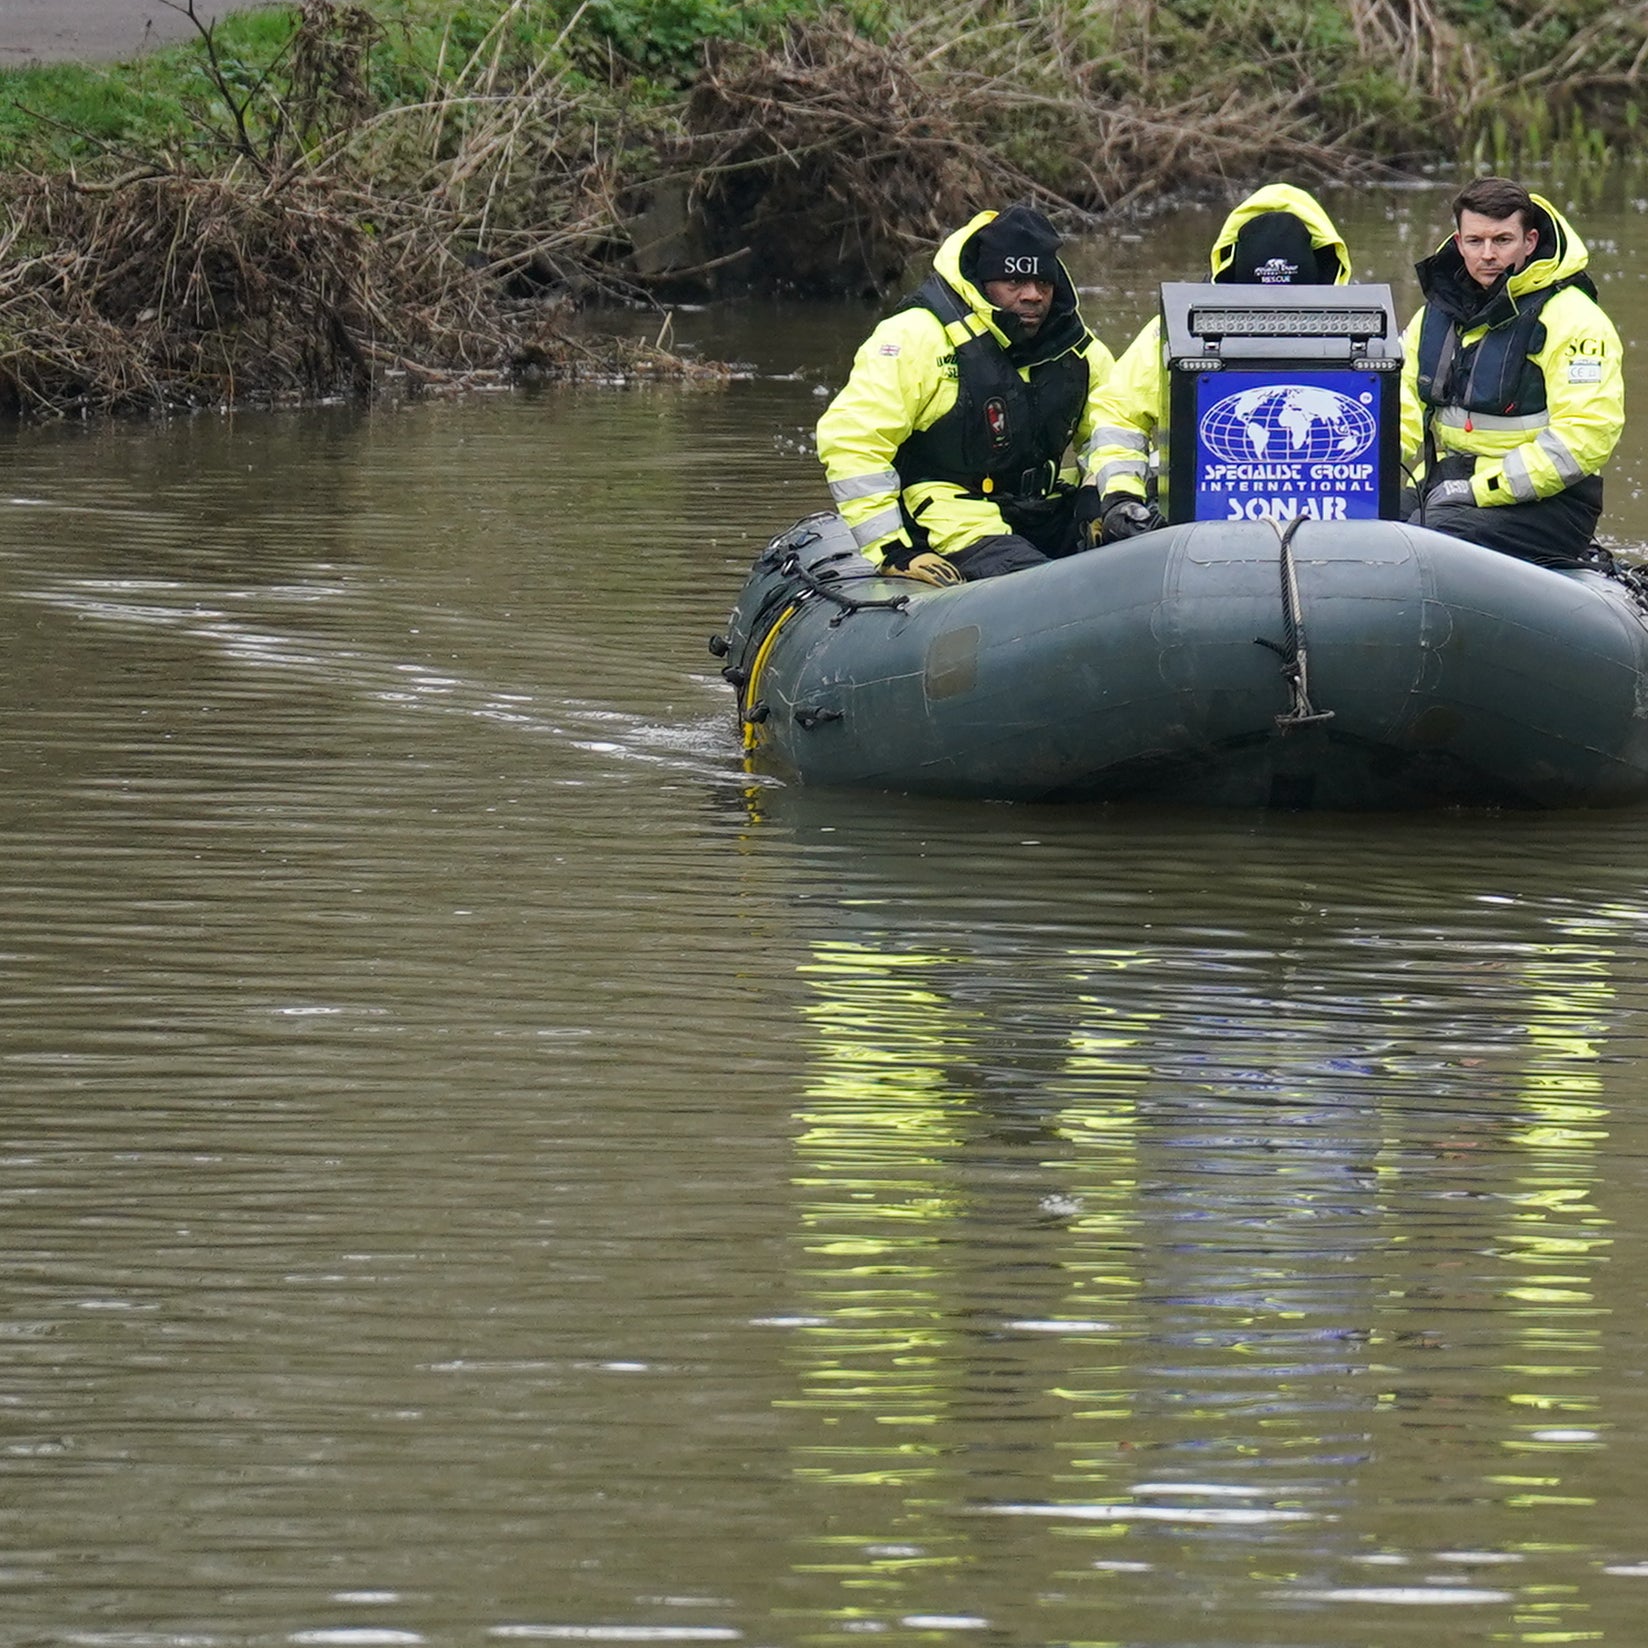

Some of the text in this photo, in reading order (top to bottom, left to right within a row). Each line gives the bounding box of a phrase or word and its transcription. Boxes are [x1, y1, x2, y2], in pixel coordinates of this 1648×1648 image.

[1004, 255, 1039, 275] SGI
[1564, 338, 1606, 358] SGI
[1204, 464, 1374, 480] SPECIALIST GROUP
[1201, 481, 1374, 492] INTERNATIONAL
[1227, 496, 1348, 521] SONAR
